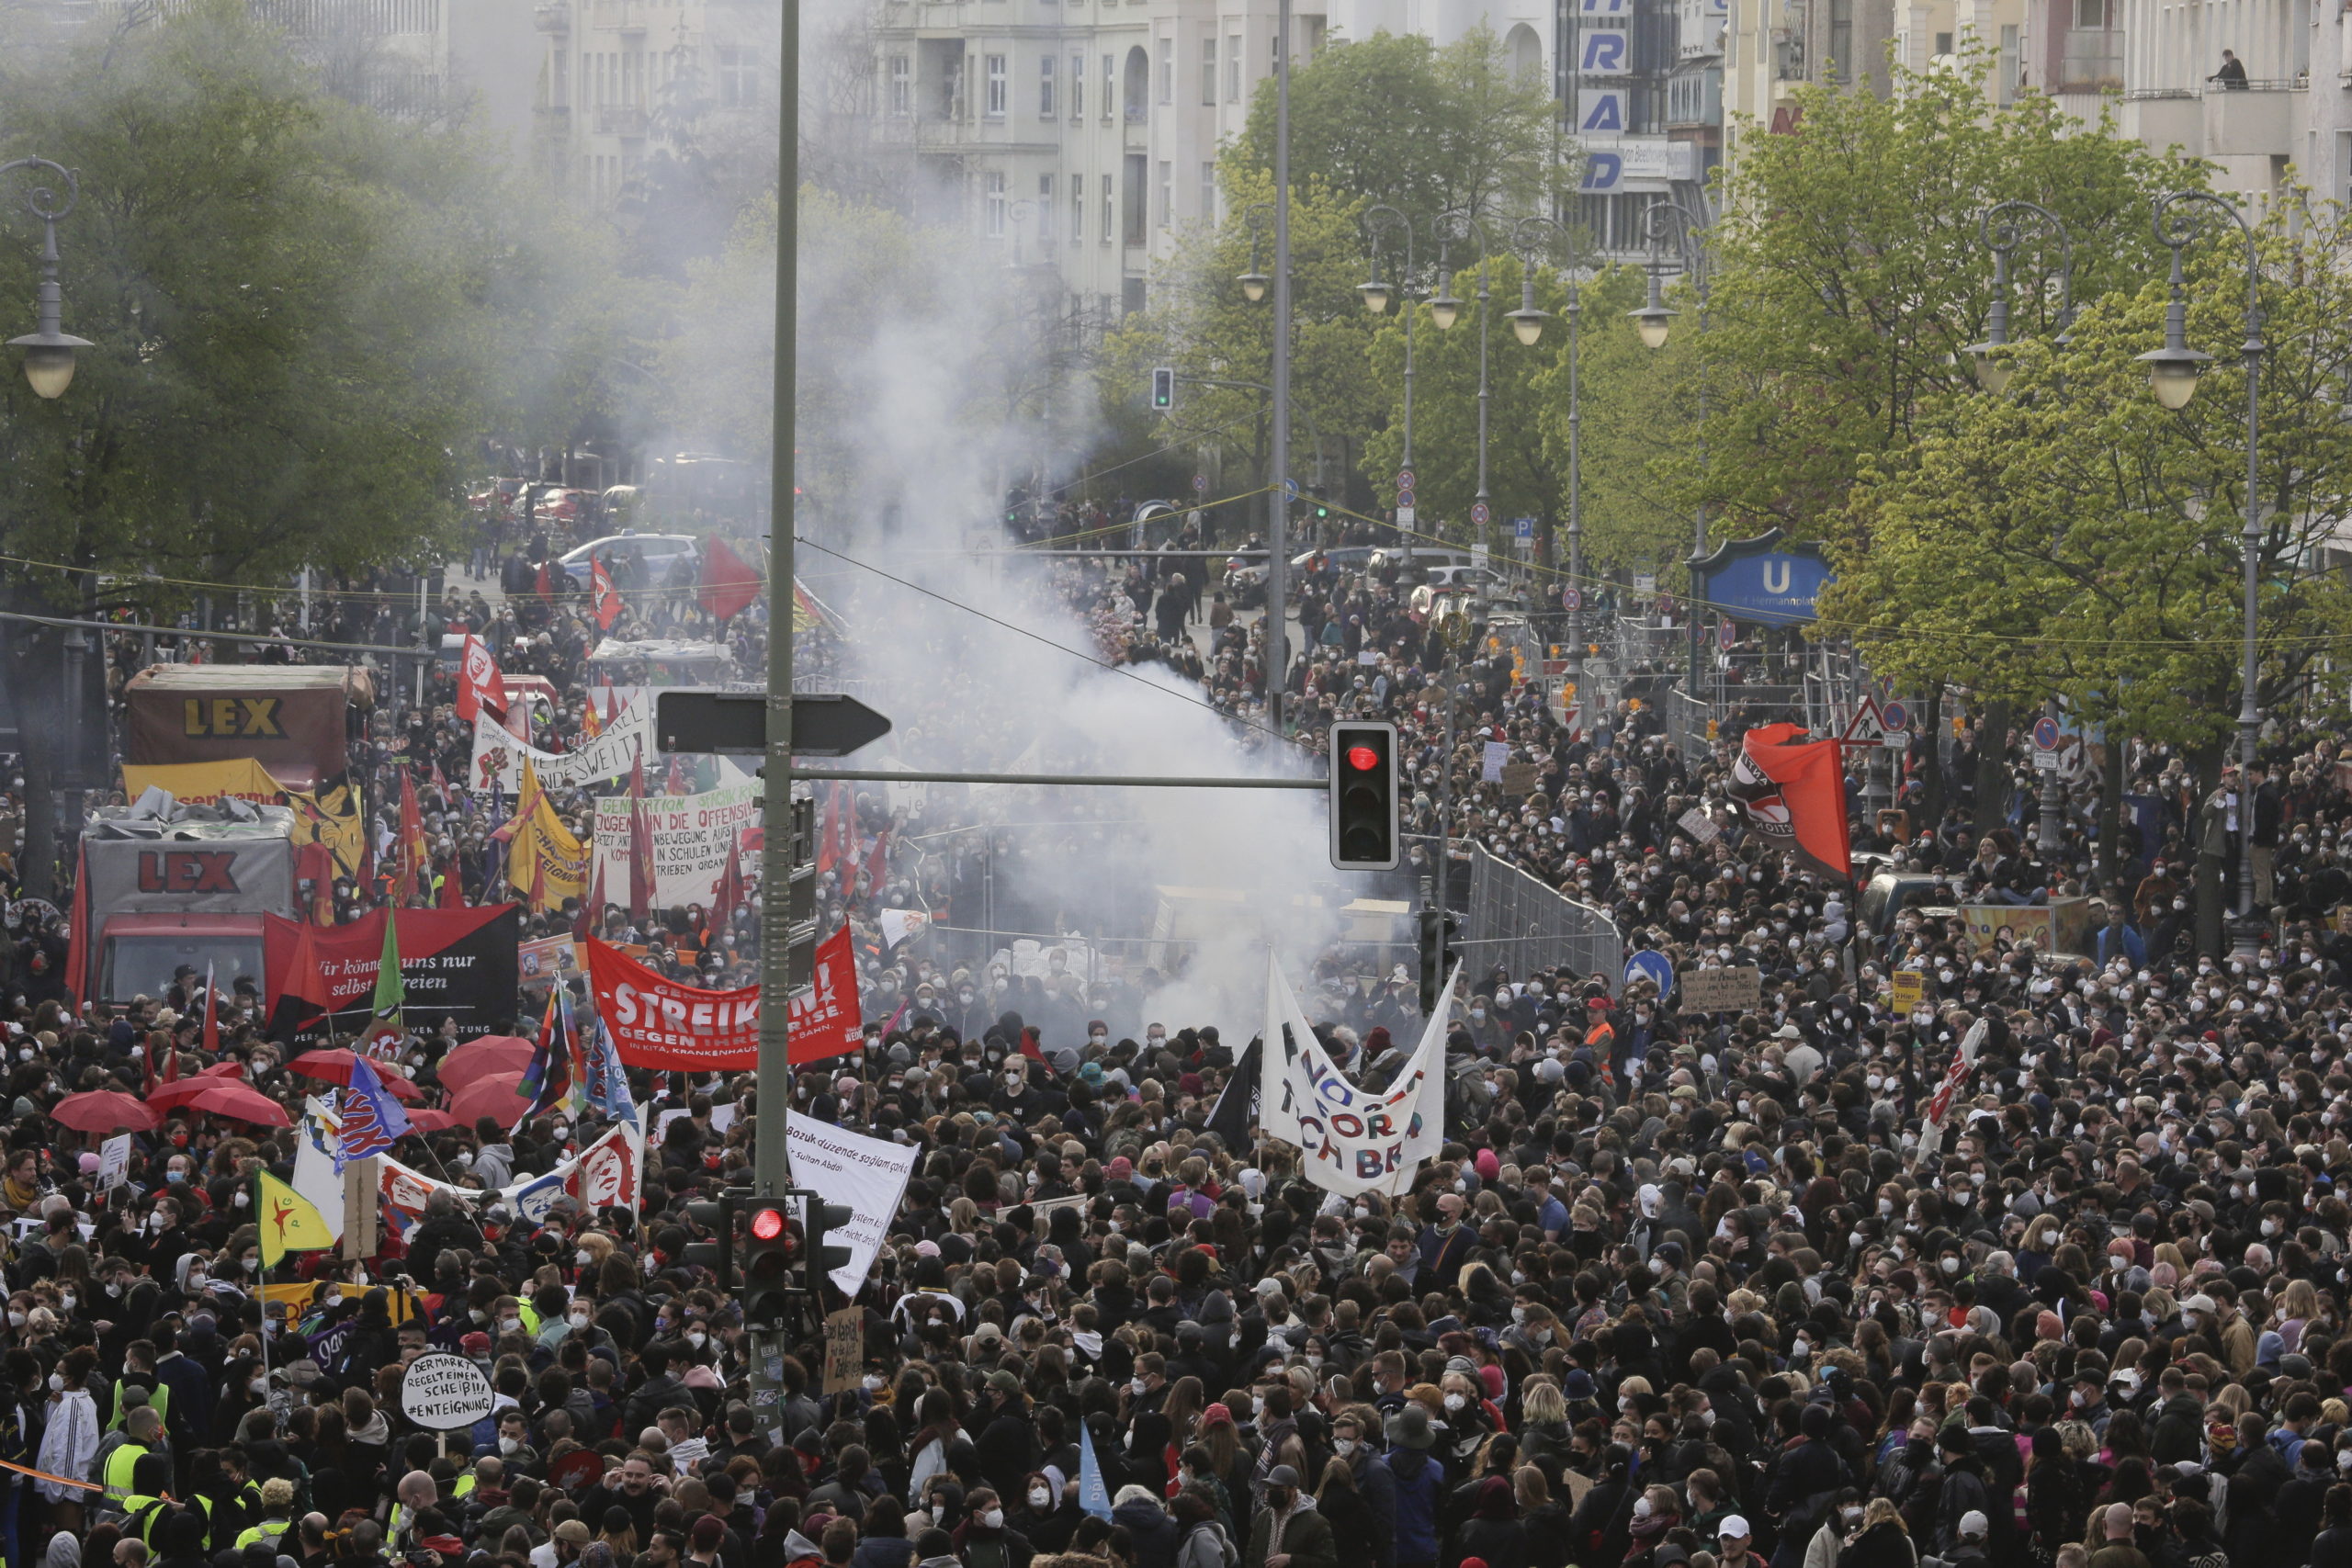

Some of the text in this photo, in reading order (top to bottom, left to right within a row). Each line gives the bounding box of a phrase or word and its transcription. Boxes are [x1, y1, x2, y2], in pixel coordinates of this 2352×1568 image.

[1763, 560, 1791, 594] U
[185, 698, 283, 738] LEX
[669, 813, 689, 830] DIE
[669, 842, 710, 861] SCHULEN
[139, 852, 239, 893] LEX
[344, 957, 381, 975] könne
[442, 953, 476, 968] nur
[332, 978, 372, 996] selbst
[618, 1026, 695, 1047] GEGEN
[787, 1008, 843, 1034] RISE.
[629, 1042, 640, 1052] IN
[799, 1023, 834, 1040] BAHN.
[795, 1151, 820, 1167] Sultan
[817, 1137, 860, 1161] düzende
[844, 1230, 863, 1244] nicht
[414, 1358, 471, 1373] DER MARKT
